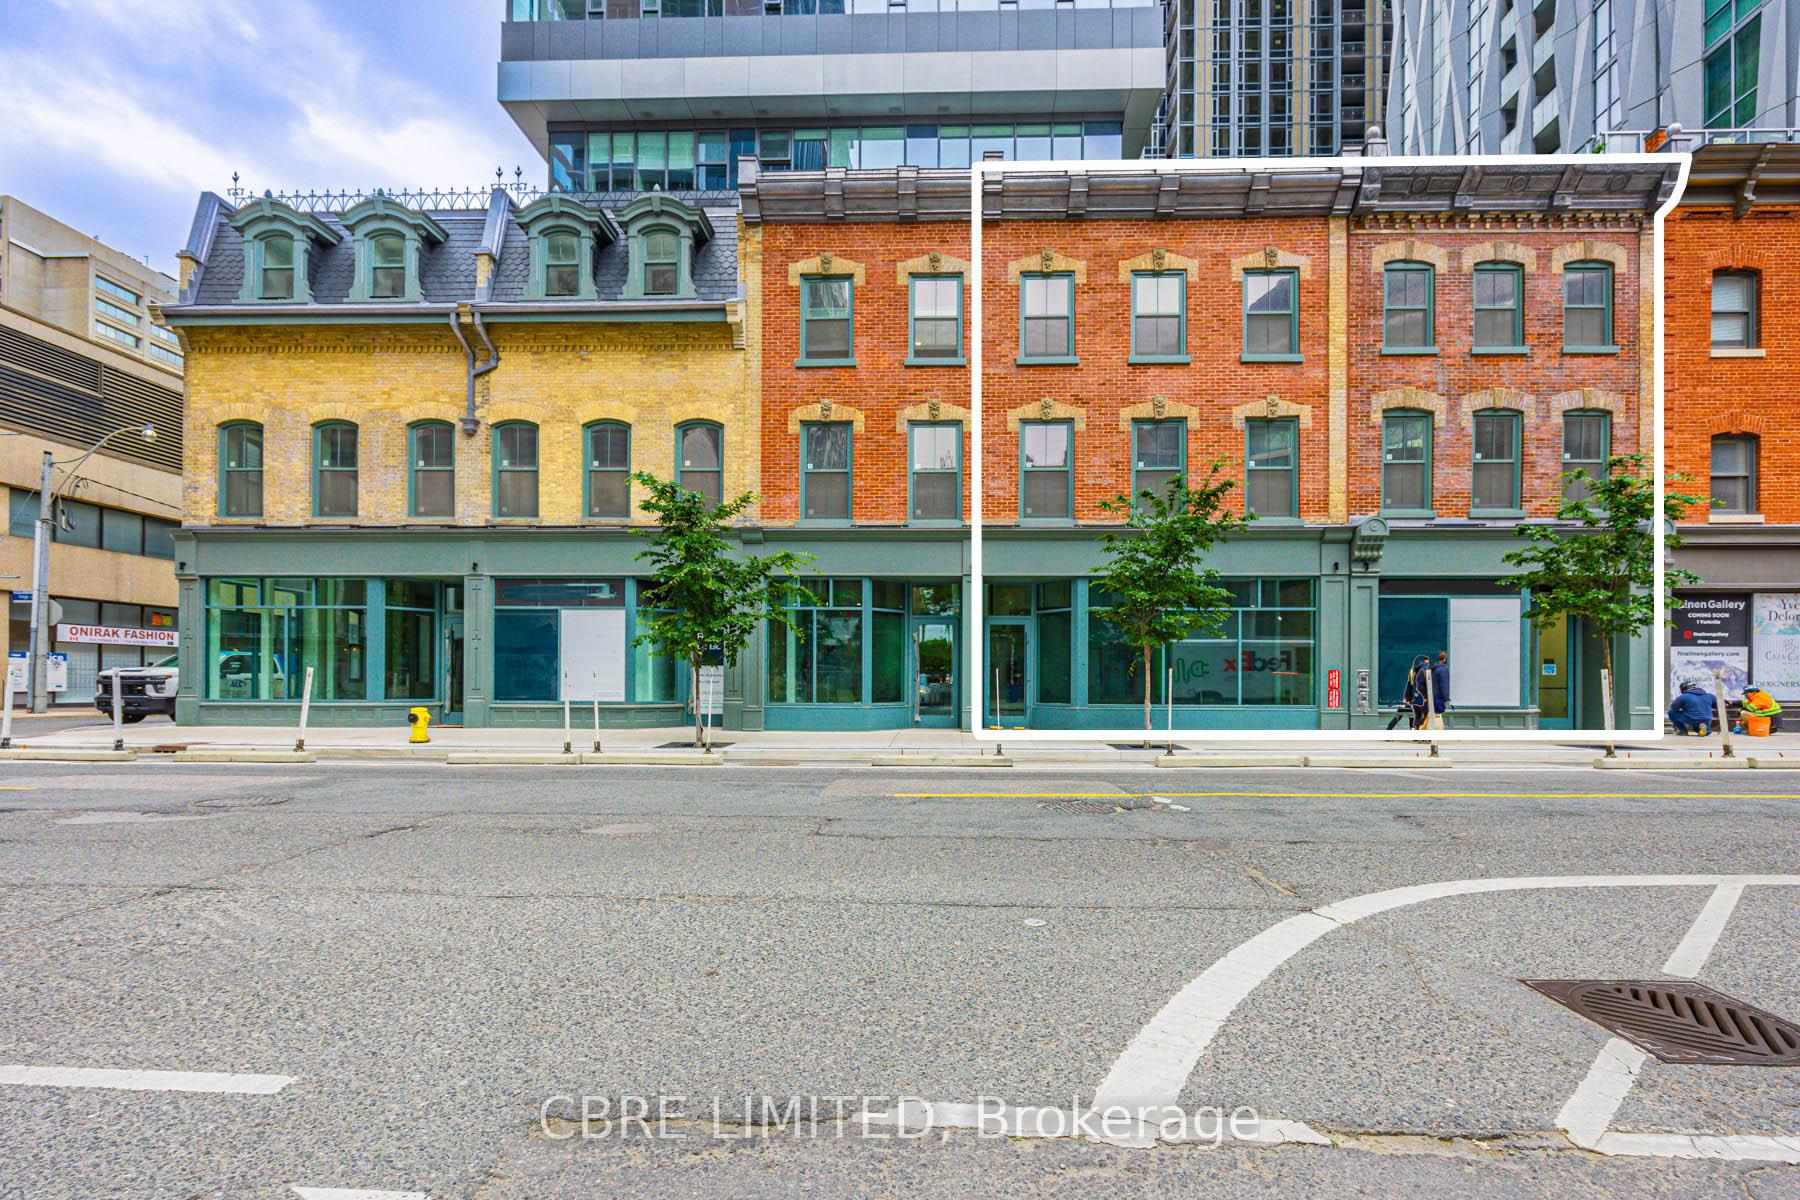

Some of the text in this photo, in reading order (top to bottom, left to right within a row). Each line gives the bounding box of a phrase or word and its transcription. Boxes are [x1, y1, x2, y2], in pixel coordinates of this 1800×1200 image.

[1708, 600, 1745, 611] Gallery
[69, 626, 175, 641] ONIRAK FASHION
[1677, 650, 1740, 658] finelinengallery.com
